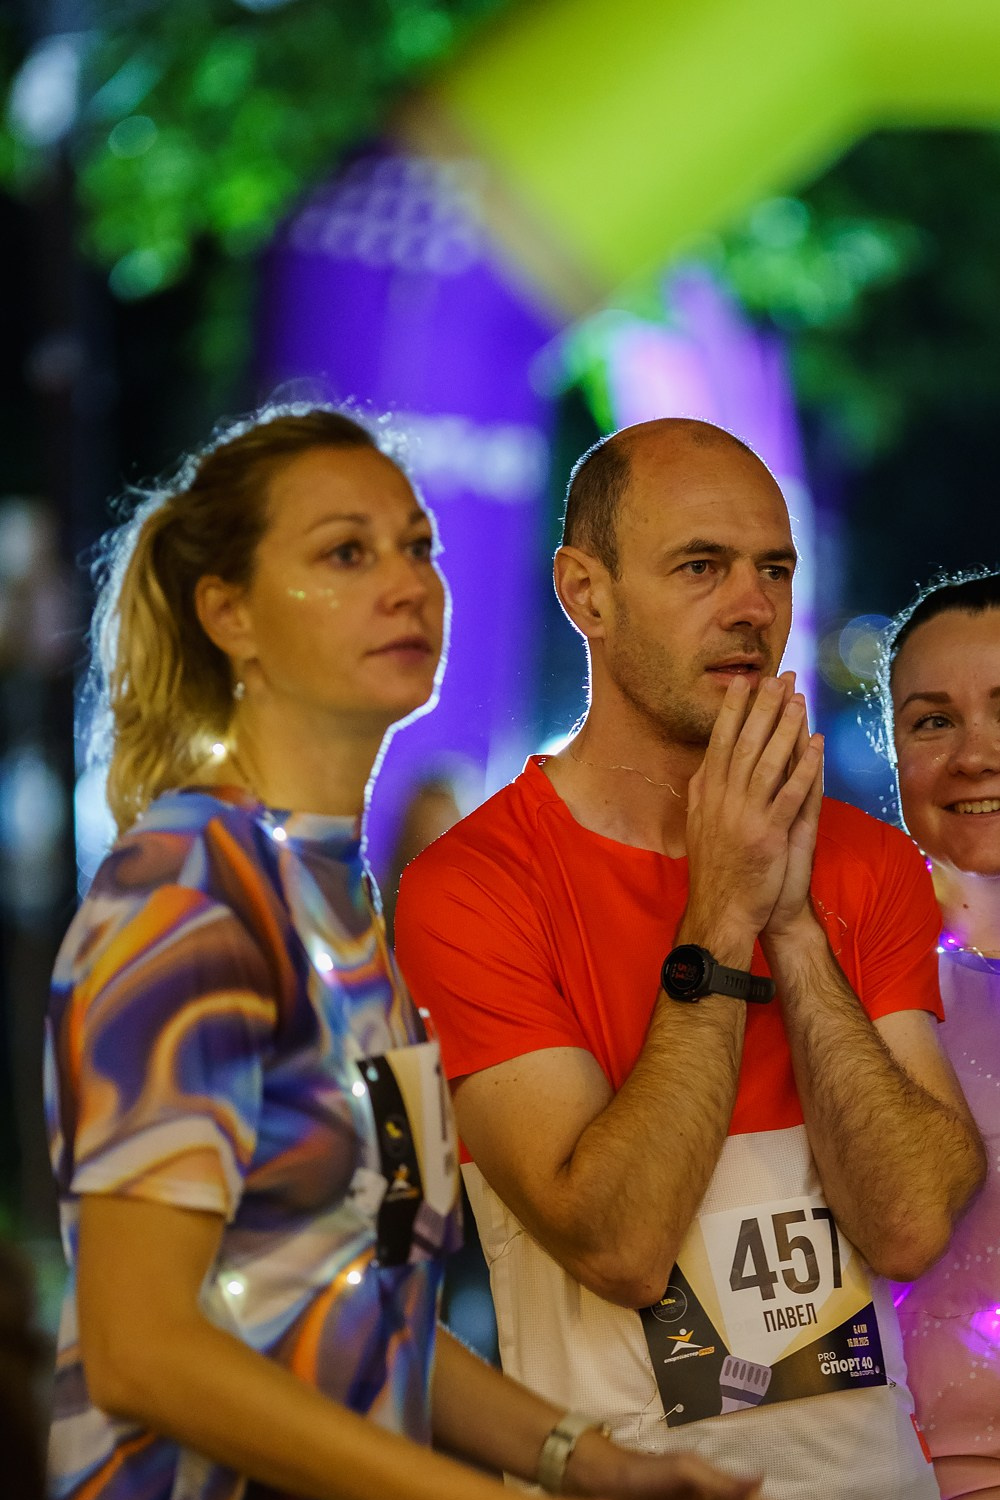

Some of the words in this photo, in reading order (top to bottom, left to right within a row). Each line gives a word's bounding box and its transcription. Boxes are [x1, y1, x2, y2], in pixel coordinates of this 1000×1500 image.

[729, 1207, 843, 1301] 457
[763, 1302, 818, 1333] ПАВЕЛ
[817, 1351, 837, 1362] PRO
[820, 1357, 861, 1375] СПОРТ
[862, 1356, 874, 1370] 40
